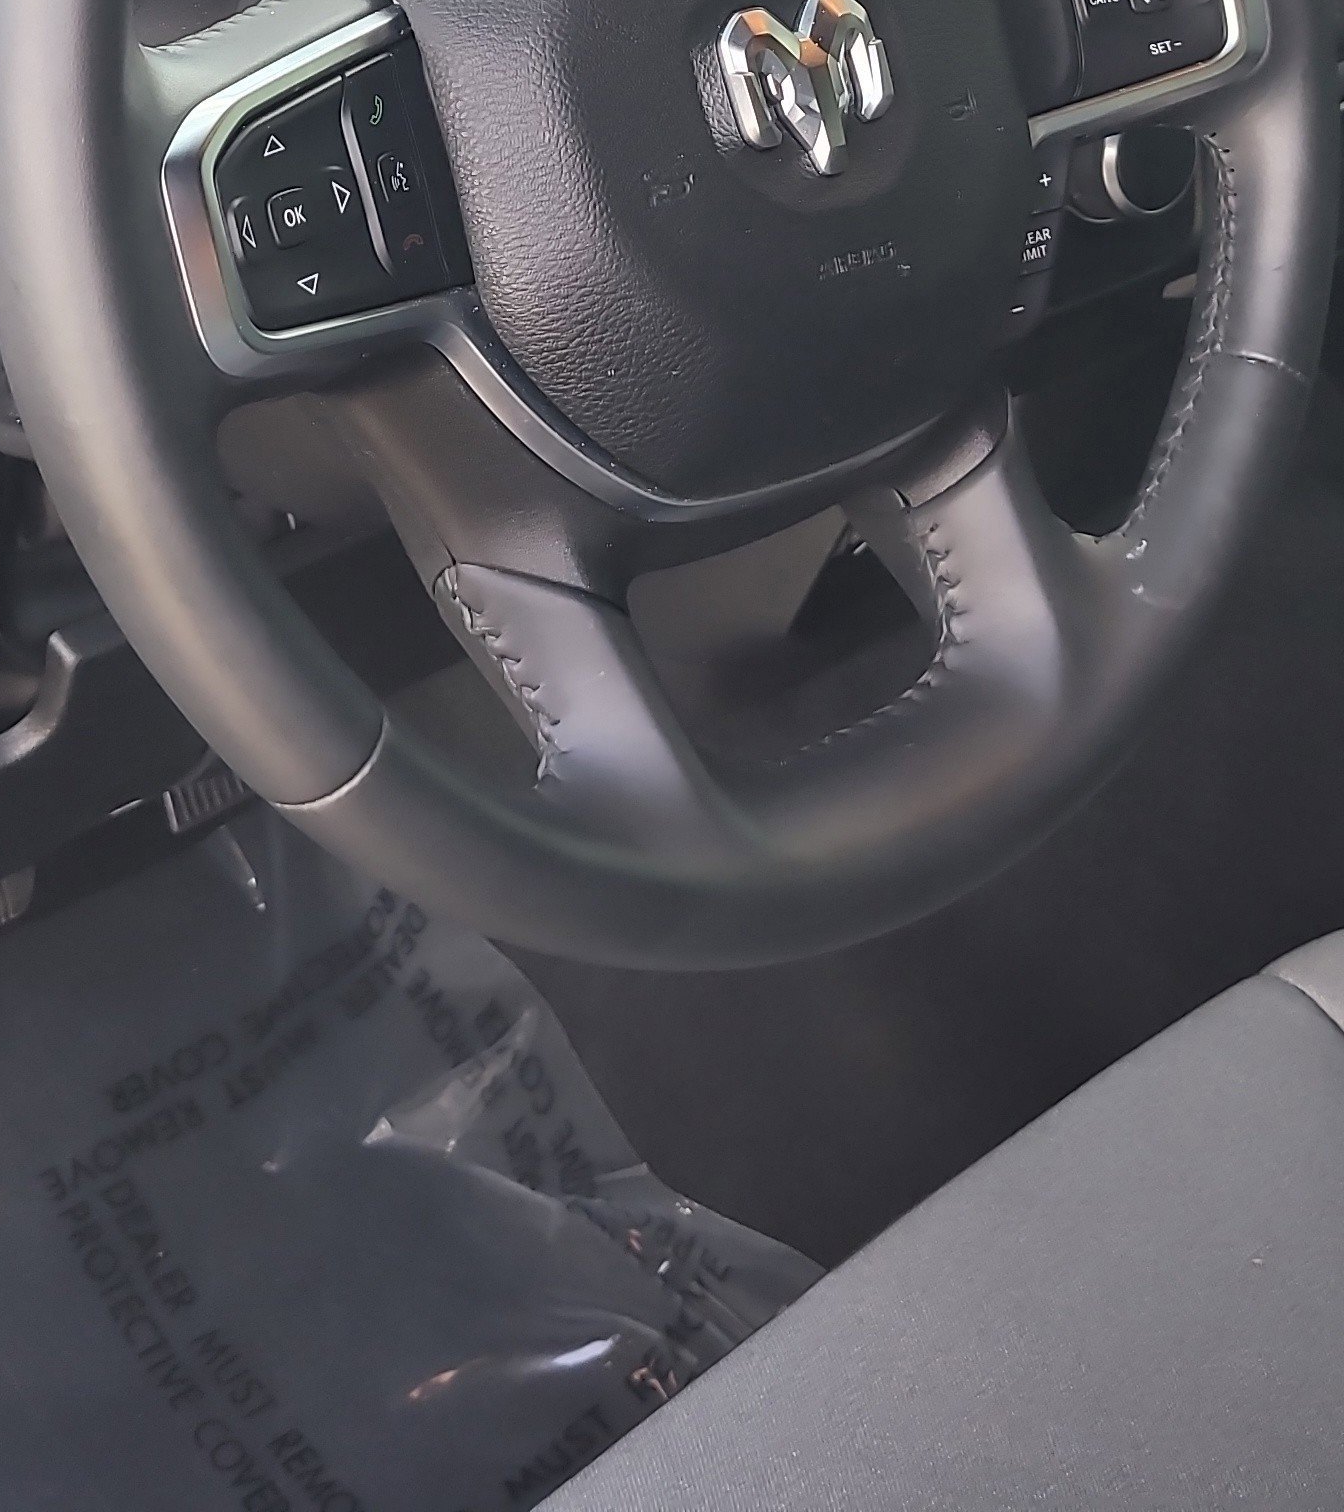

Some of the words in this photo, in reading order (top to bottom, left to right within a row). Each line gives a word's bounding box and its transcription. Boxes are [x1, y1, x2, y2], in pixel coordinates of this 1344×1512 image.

[283, 205, 307, 228] OK
[1025, 228, 1052, 246] EAR
[192, 1329, 278, 1421] MUST
